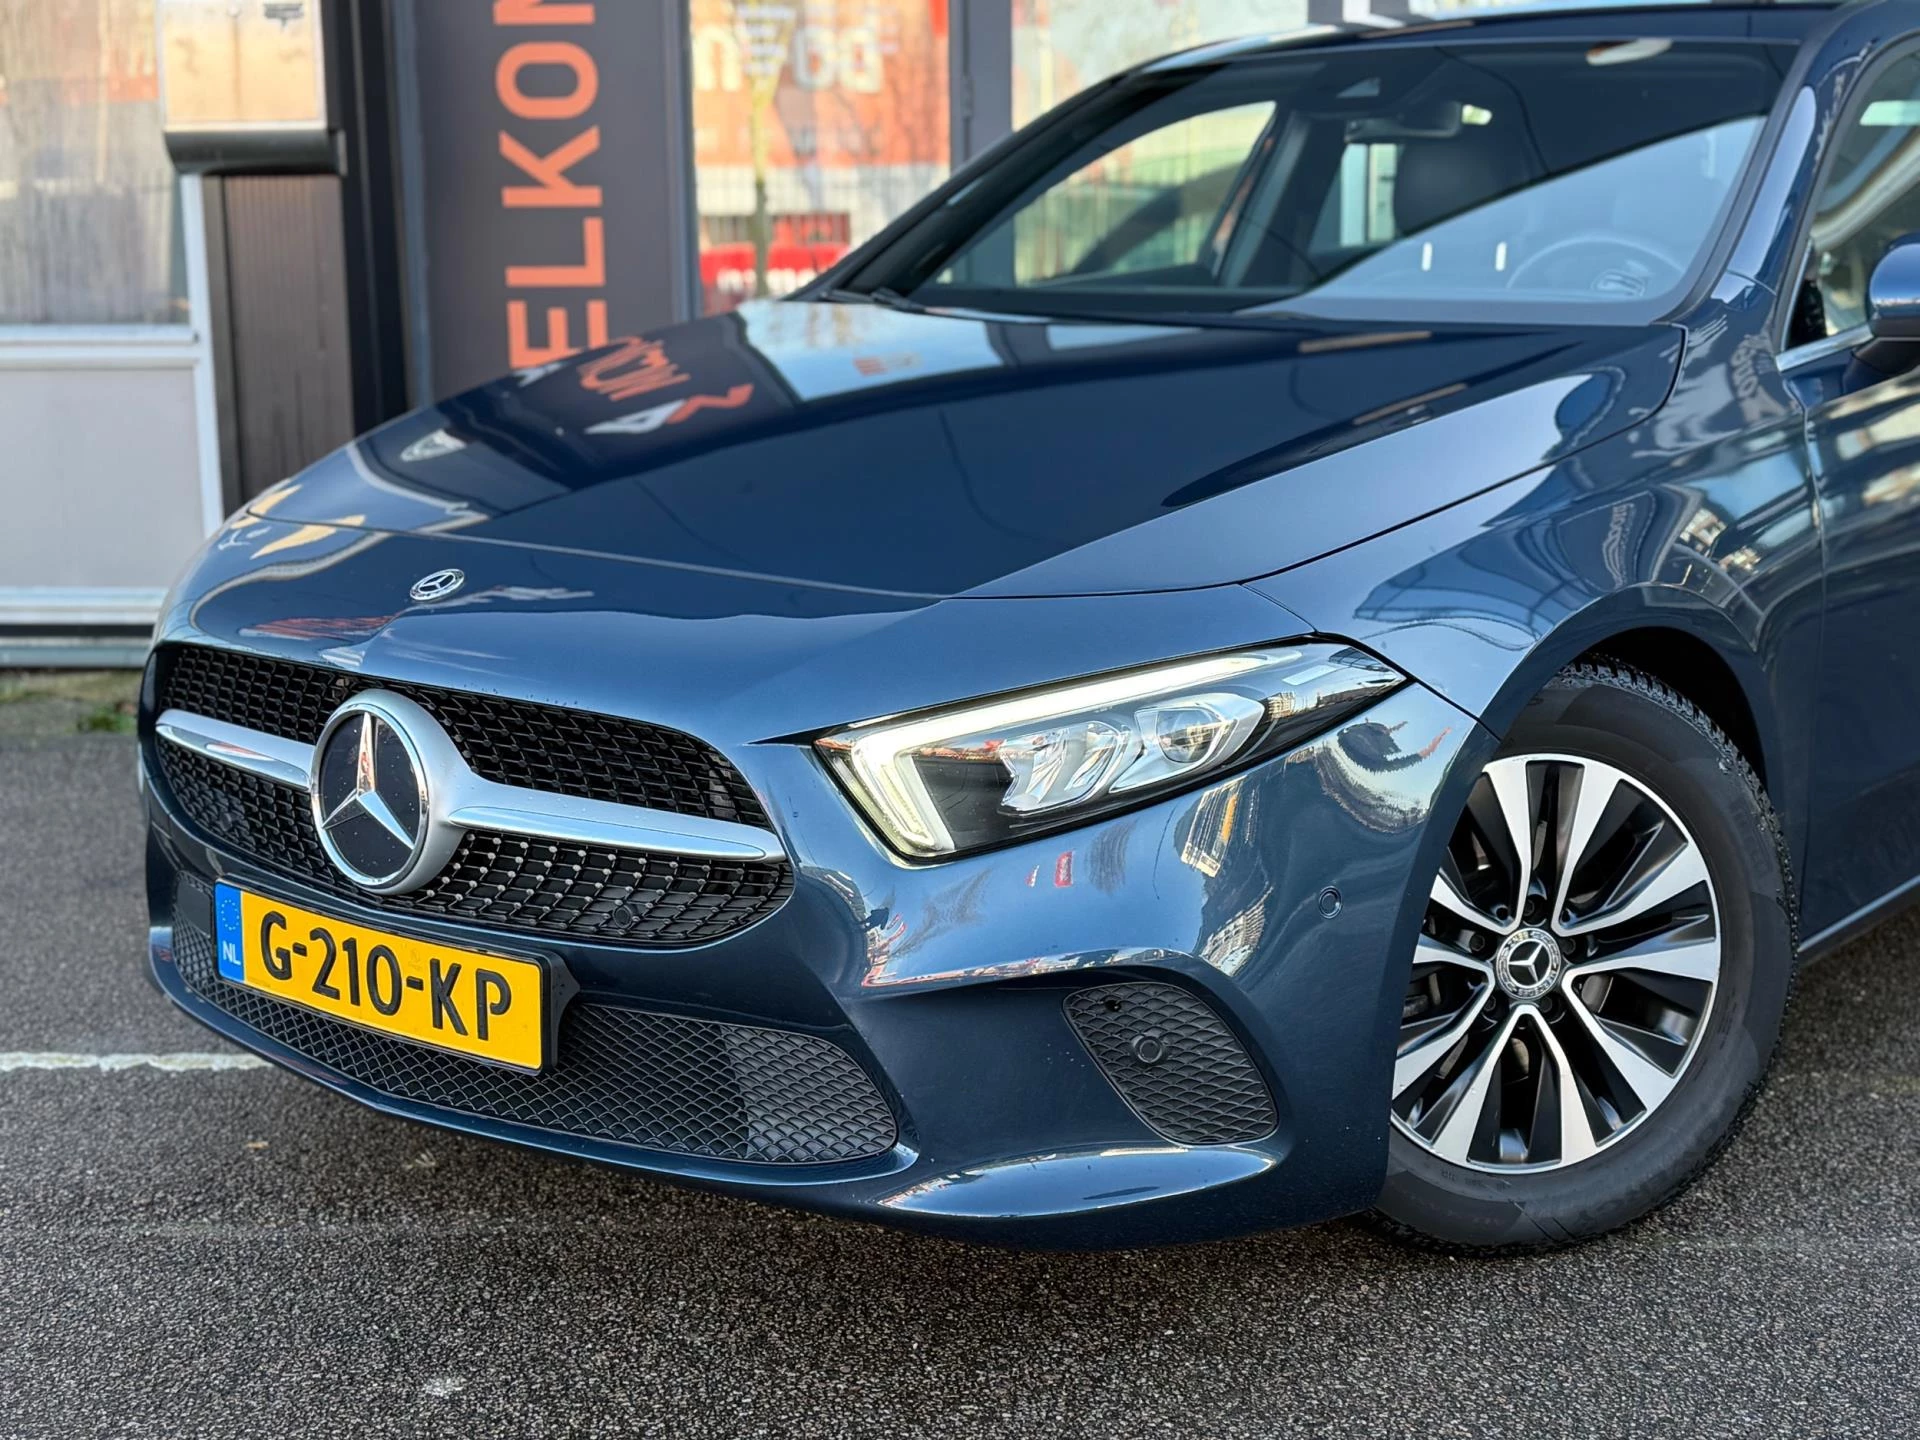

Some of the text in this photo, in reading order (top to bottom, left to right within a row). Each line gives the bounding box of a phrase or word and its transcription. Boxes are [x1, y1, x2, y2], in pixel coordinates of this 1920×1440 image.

[493, 0, 608, 369] ELKO
[222, 940, 241, 965] NL
[260, 911, 512, 1041] G-210-KP
